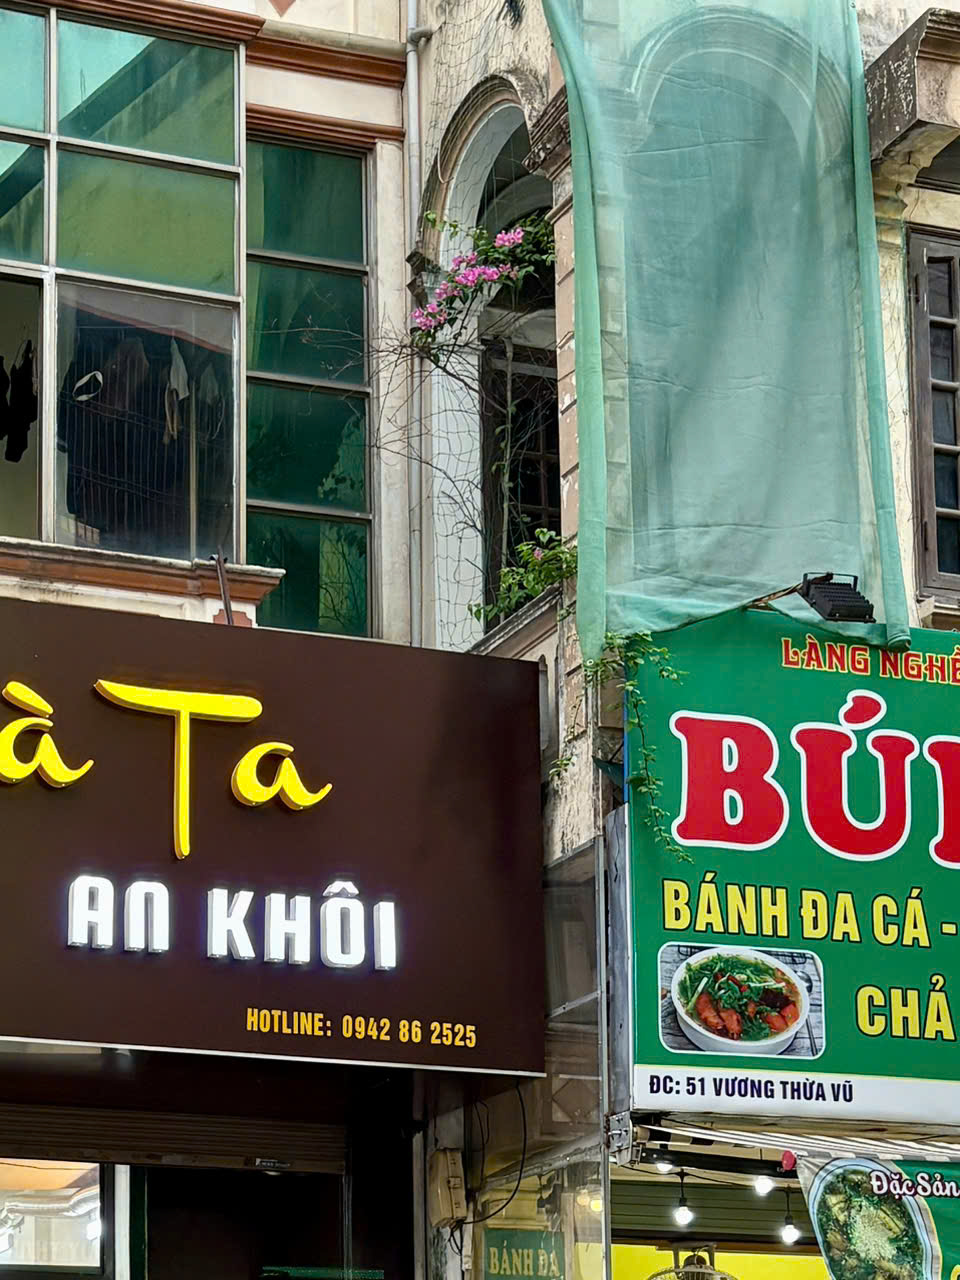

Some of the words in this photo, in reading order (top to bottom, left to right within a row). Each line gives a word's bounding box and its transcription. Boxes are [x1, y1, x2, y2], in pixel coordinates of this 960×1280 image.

[781, 633, 870, 676] LÀNG
[93, 677, 332, 861] Ta
[67, 874, 169, 953] AN
[206, 880, 397, 972] KHÔI
[661, 871, 789, 938] BÁNH
[799, 888, 862, 944] ĐA
[871, 888, 932, 948] CÁ
[246, 1006, 333, 1038] HOTLINE:
[341, 1014, 391, 1042] 0942
[398, 1019, 422, 1044] 86
[429, 1021, 478, 1049] 2525
[854, 974, 958, 1041] CHẢ
[649, 1074, 681, 1096] ĐC:
[685, 1075, 707, 1097] 51
[712, 1076, 776, 1100] VƯƠNG
[780, 1077, 827, 1103] THỪA
[830, 1078, 855, 1103] VŨ
[869, 1170, 916, 1200] Đặc
[916, 1172, 960, 1199] Sản
[489, 1240, 534, 1276] BÁNH
[536, 1247, 561, 1277] ĐA
